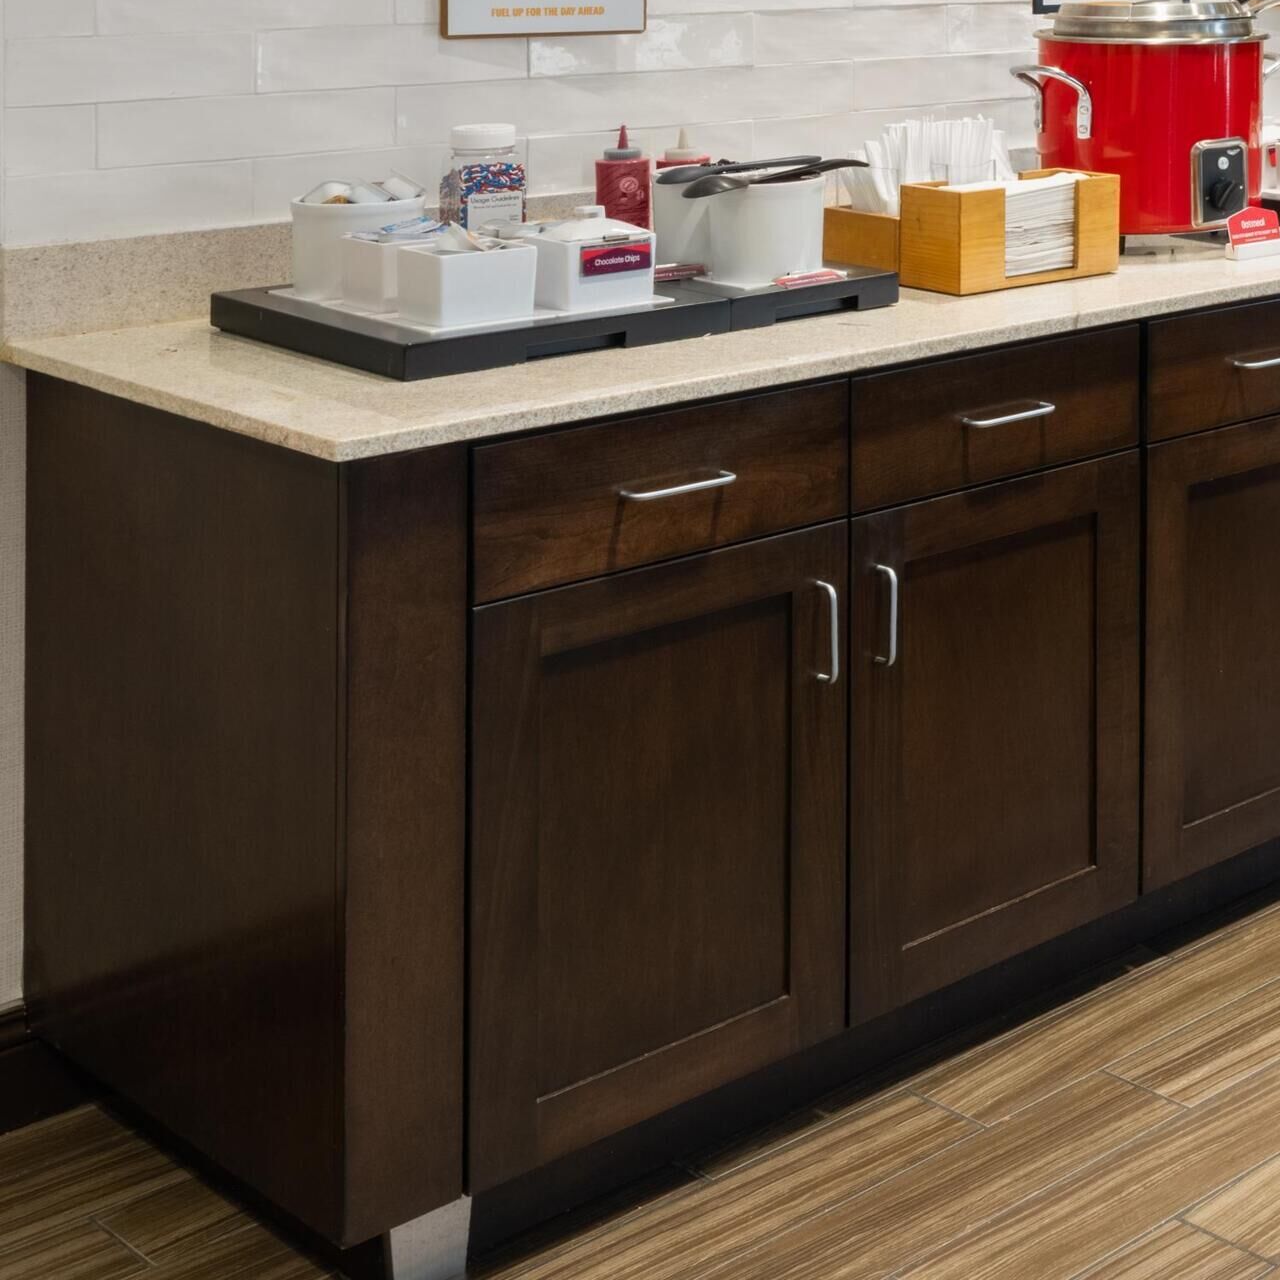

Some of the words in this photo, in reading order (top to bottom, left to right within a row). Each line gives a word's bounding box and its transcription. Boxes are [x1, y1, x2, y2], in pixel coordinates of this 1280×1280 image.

[491, 7, 510, 18] FUEL
[513, 7, 524, 17] UP
[526, 7, 541, 17] FOR
[544, 6, 558, 17] THE
[578, 5, 605, 16] AHEAD
[594, 256, 624, 266] Chocolate
[624, 254, 640, 265] Chips
